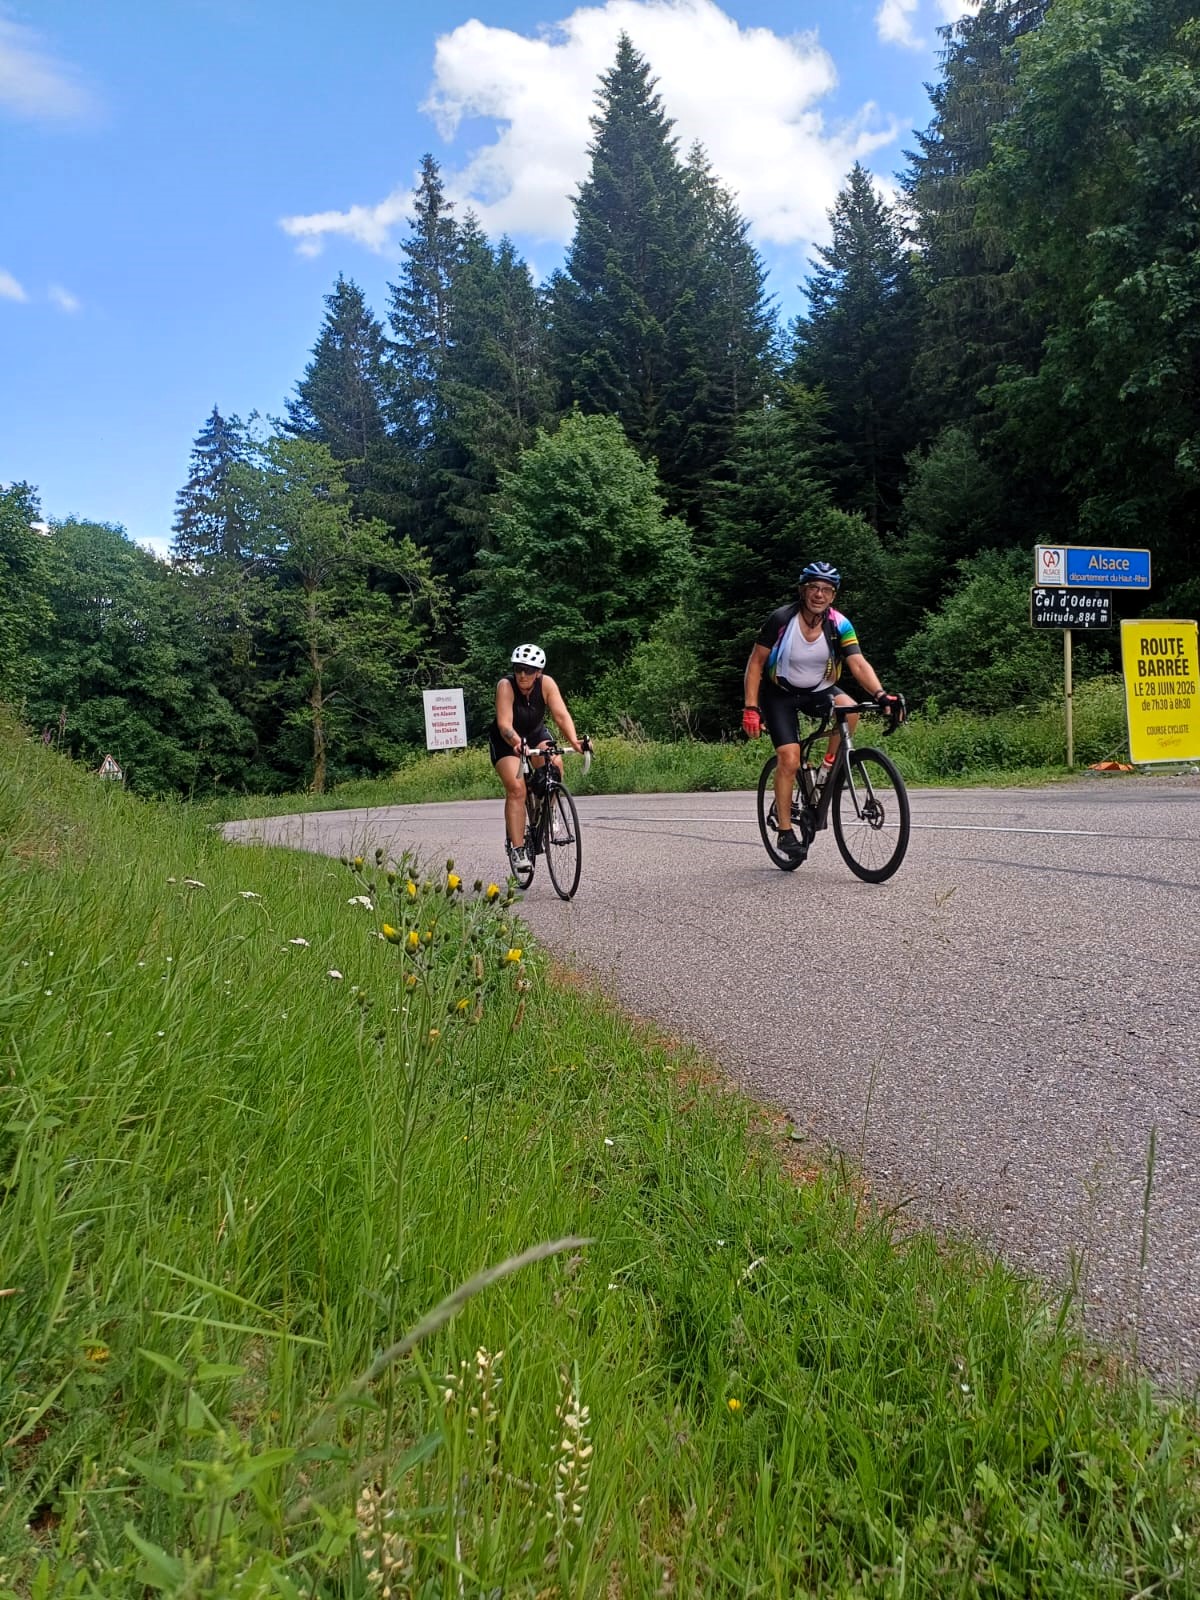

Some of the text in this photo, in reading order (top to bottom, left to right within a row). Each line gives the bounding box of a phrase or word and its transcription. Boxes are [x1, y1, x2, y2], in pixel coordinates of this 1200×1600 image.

[1088, 554, 1130, 571] Alsace
[1070, 574, 1109, 583] département
[1119, 575, 1148, 583] Haut-Rhin
[1035, 595, 1109, 607] Col d'Oderen
[1037, 611, 1108, 622] altitude 884 m
[1140, 638, 1185, 656] ROUTE
[1137, 655, 1190, 677] BARRÉE
[1134, 681, 1196, 697] LE 28 JUIN 2026
[1142, 698, 1191, 711] de 7h30 à 8h30
[1146, 724, 1189, 736] COURSE CYCLISTE
